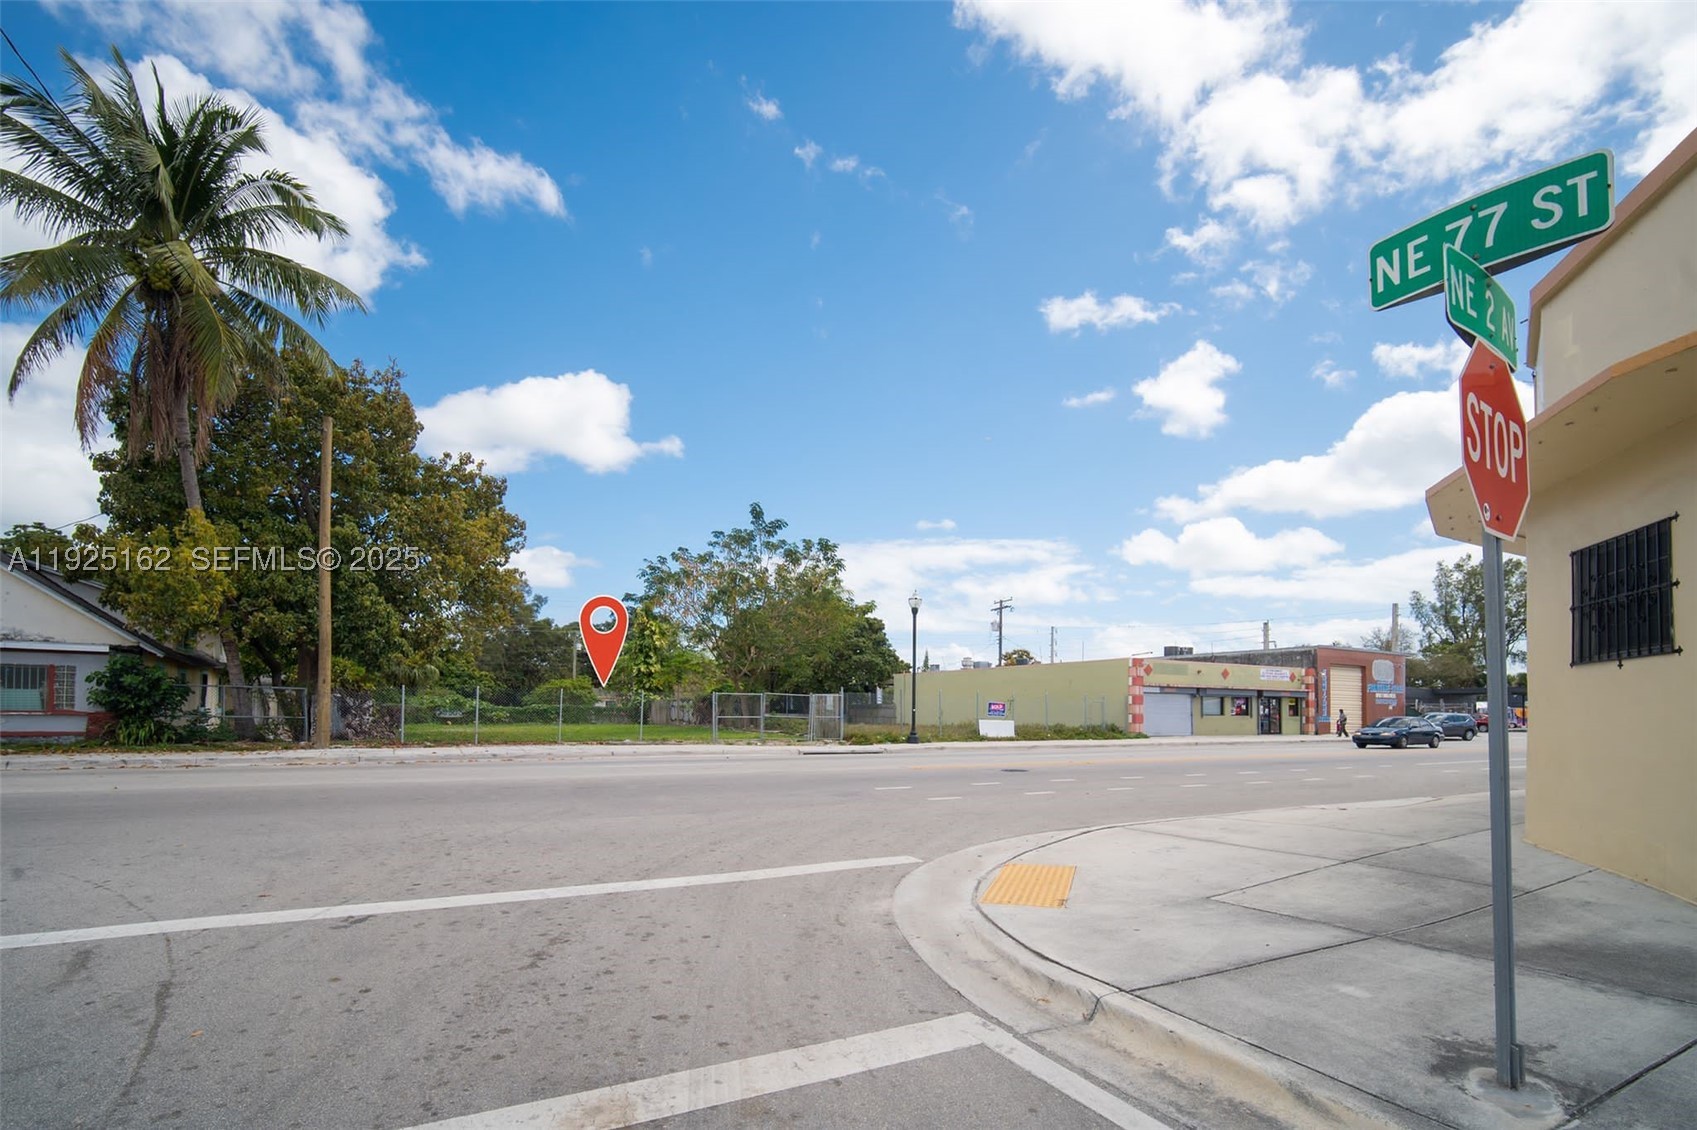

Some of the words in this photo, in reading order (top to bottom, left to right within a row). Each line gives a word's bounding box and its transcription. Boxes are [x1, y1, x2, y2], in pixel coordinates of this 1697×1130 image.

[1376, 234, 1431, 293] NE
[1445, 201, 1508, 253] 77
[1530, 170, 1598, 230] ST
[1450, 264, 1478, 319] NE
[1485, 289, 1496, 332] 2
[1502, 306, 1514, 351] AV
[1466, 391, 1523, 483] STOP
